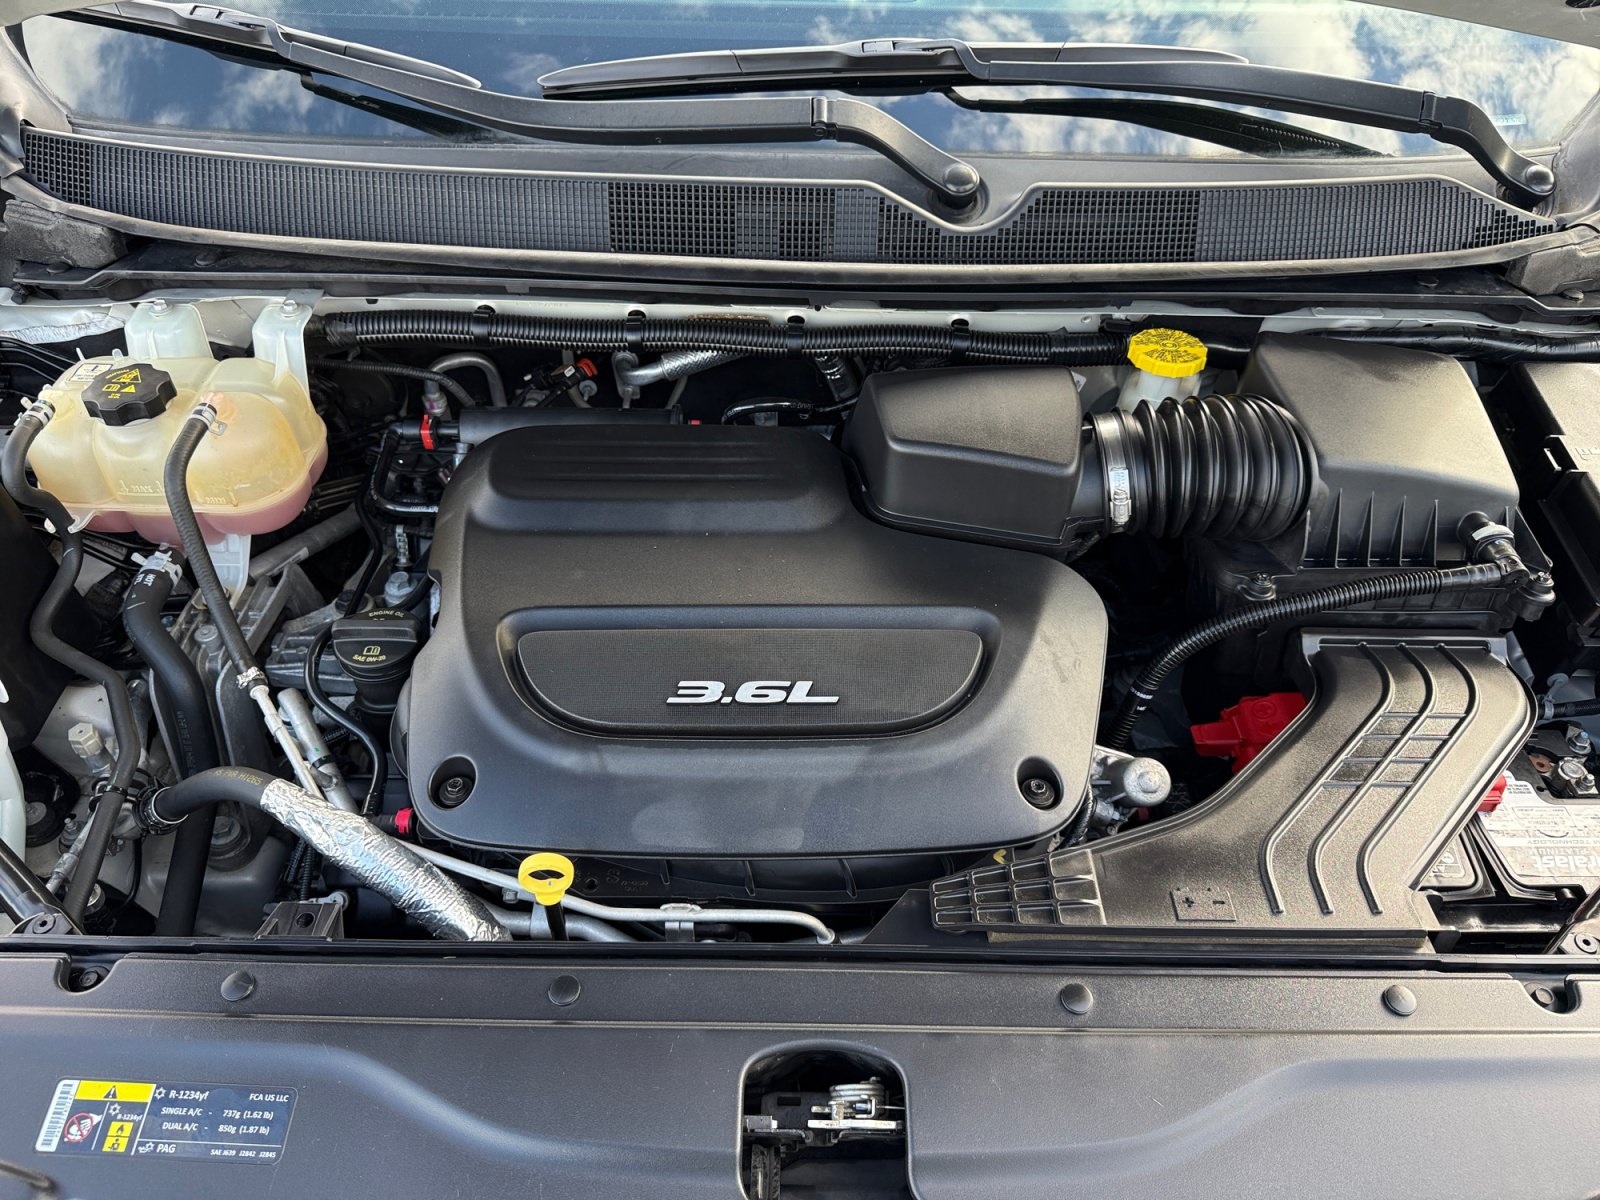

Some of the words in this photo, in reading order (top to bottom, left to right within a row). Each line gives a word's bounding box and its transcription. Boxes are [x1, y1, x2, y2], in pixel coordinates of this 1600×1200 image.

[352, 654, 367, 662] SAE
[666, 681, 840, 704] 3.6L
[168, 1090, 210, 1101] R-1234yf
[249, 1093, 263, 1101] FCA
[264, 1093, 276, 1101] US
[276, 1094, 290, 1102] LLC
[160, 1106, 187, 1116] SINGLE
[187, 1108, 203, 1117] A/C
[222, 1109, 242, 1120] 737g
[243, 1109, 263, 1120] (1.62
[262, 1110, 274, 1120] lb)
[161, 1121, 182, 1130] DUAL
[183, 1122, 199, 1132] A/C
[218, 1124, 237, 1134] 850g
[239, 1124, 259, 1135] (1.87
[258, 1125, 270, 1136] lb)
[156, 1143, 176, 1153] PAG
[210, 1148, 222, 1156] SAE
